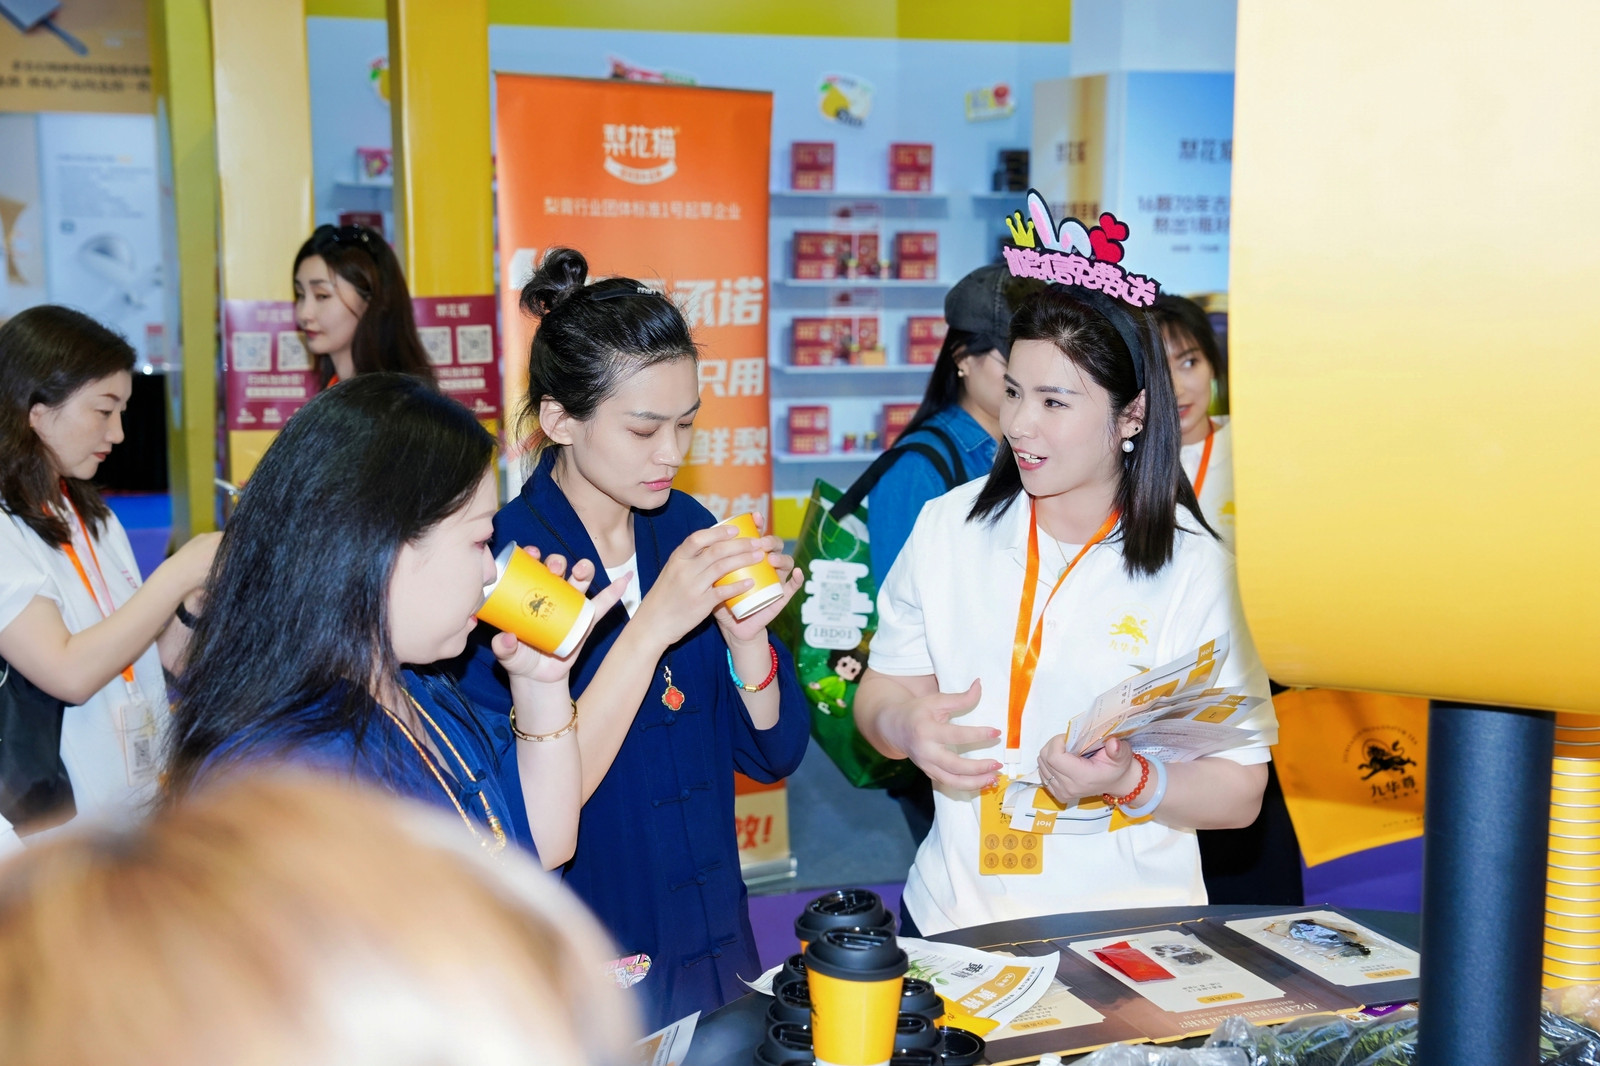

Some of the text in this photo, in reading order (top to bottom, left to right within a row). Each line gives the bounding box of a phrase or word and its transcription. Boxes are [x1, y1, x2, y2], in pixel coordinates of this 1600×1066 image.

[603, 123, 677, 159] 梨花猫
[697, 357, 765, 397] 只用
[690, 426, 768, 467] 鲜梨
[813, 627, 853, 640] 1BD01
